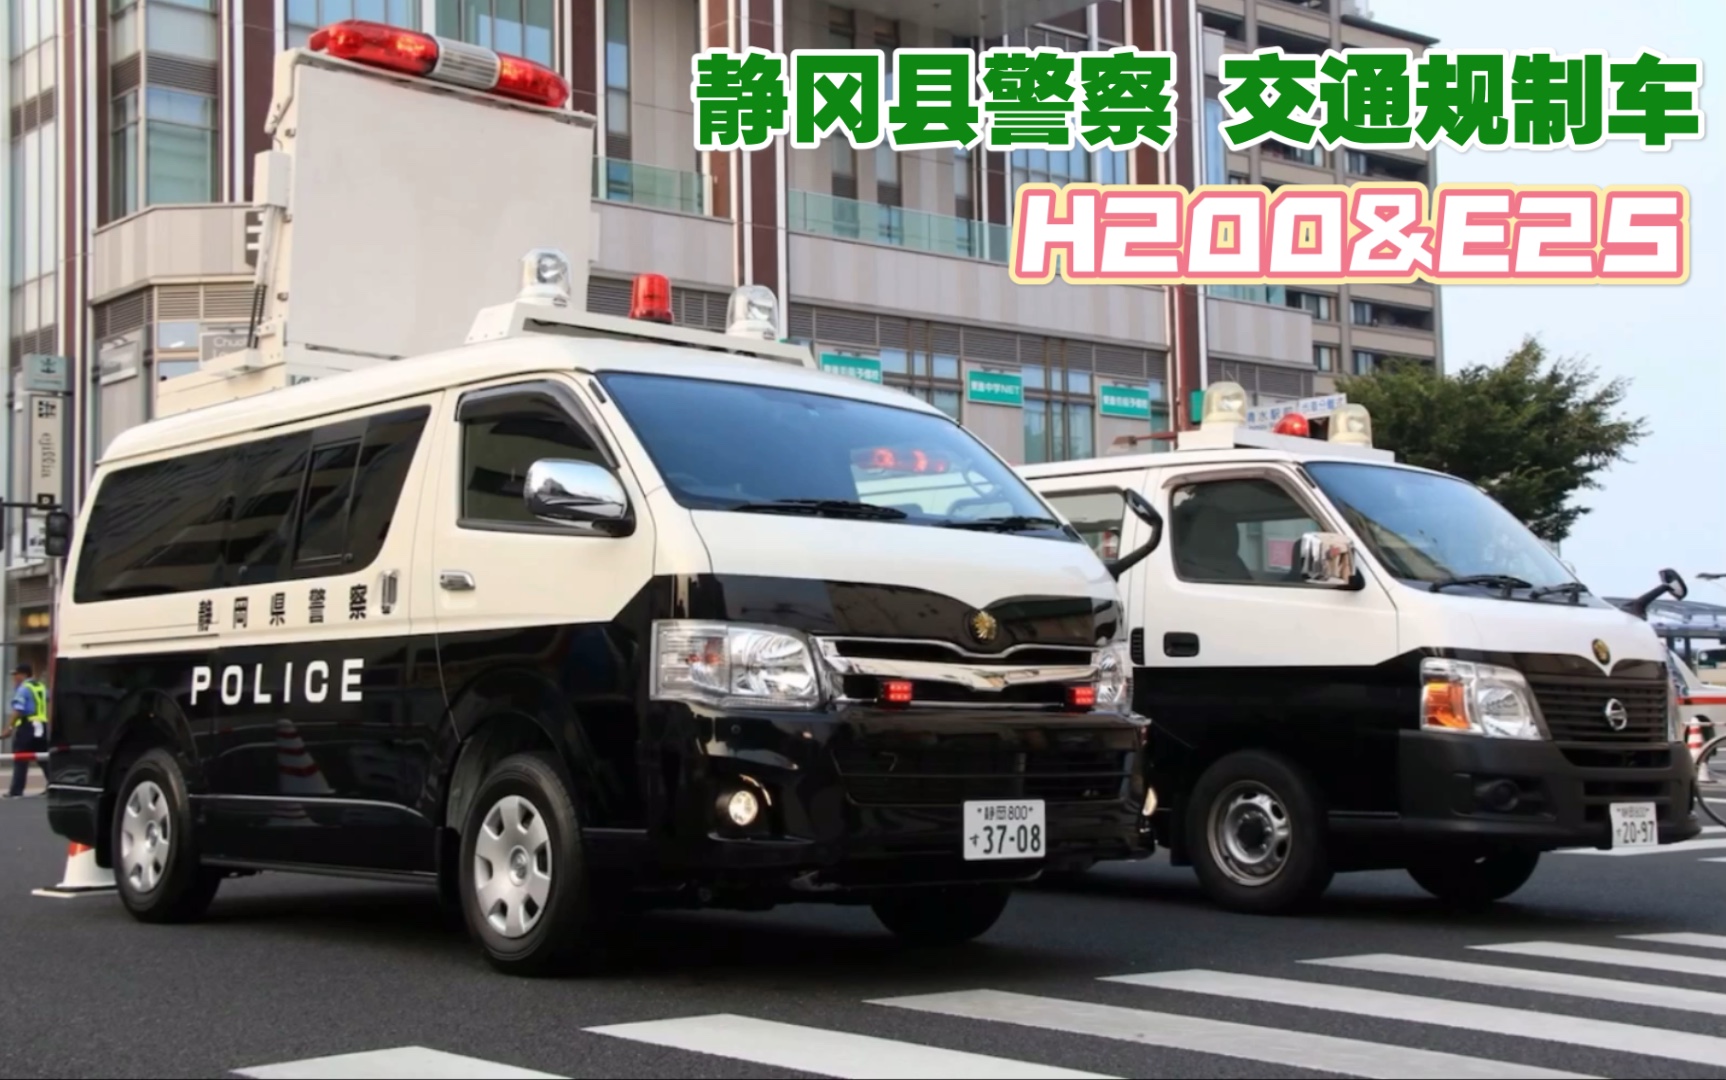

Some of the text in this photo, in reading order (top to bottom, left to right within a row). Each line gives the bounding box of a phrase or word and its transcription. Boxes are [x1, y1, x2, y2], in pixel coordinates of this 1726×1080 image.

[198, 584, 368, 632] 静岡県警察
[190, 658, 364, 706] POLICE
[984, 805, 1028, 820] 静岡800
[983, 824, 1041, 854] 37-08
[1622, 820, 1655, 844] 20-97
